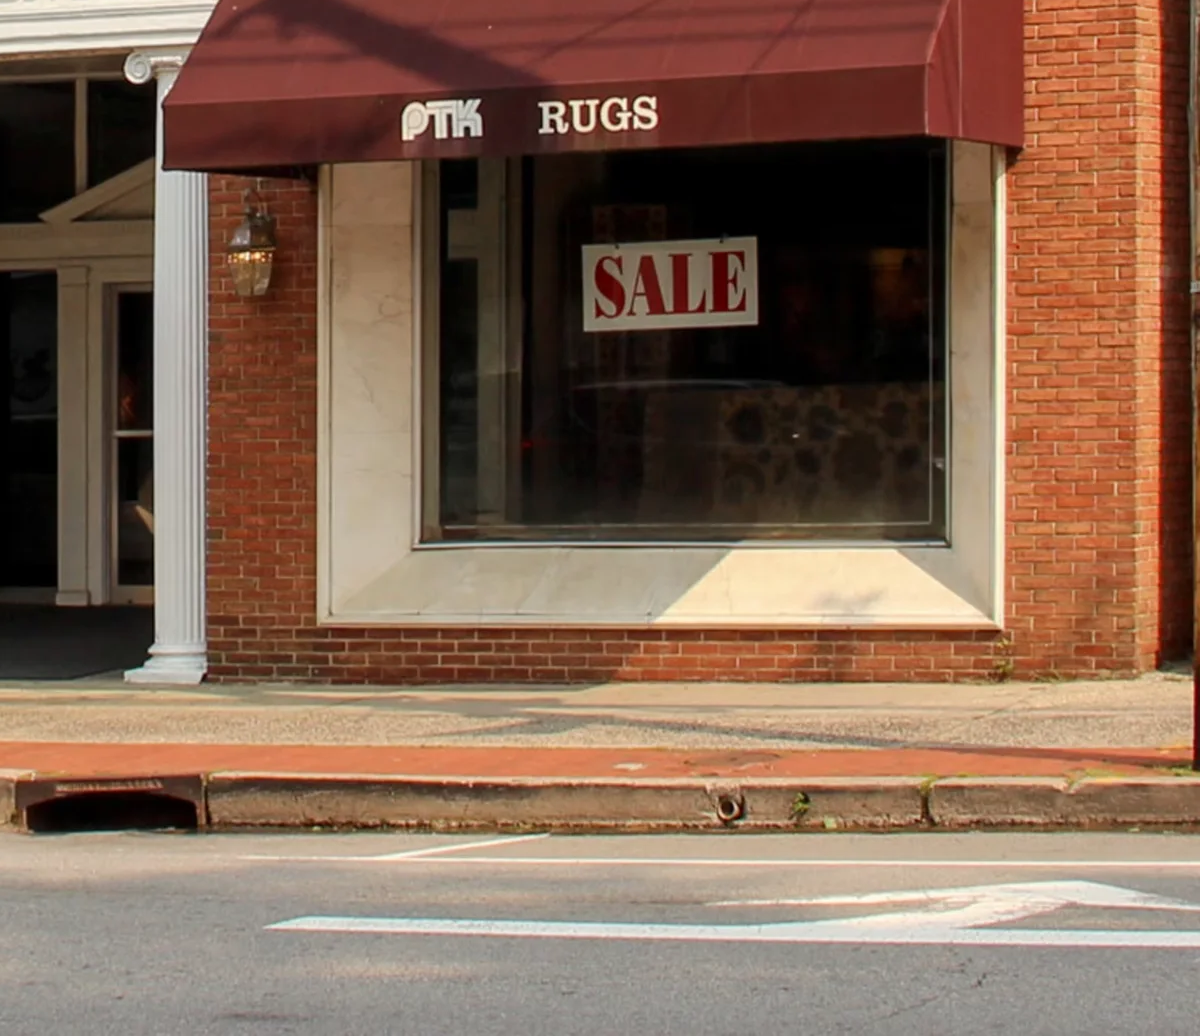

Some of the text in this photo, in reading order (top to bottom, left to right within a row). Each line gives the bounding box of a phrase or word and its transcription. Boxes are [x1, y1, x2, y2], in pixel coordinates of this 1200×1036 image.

[401, 95, 659, 141] PTK RUGS
[594, 250, 747, 320] SALE
